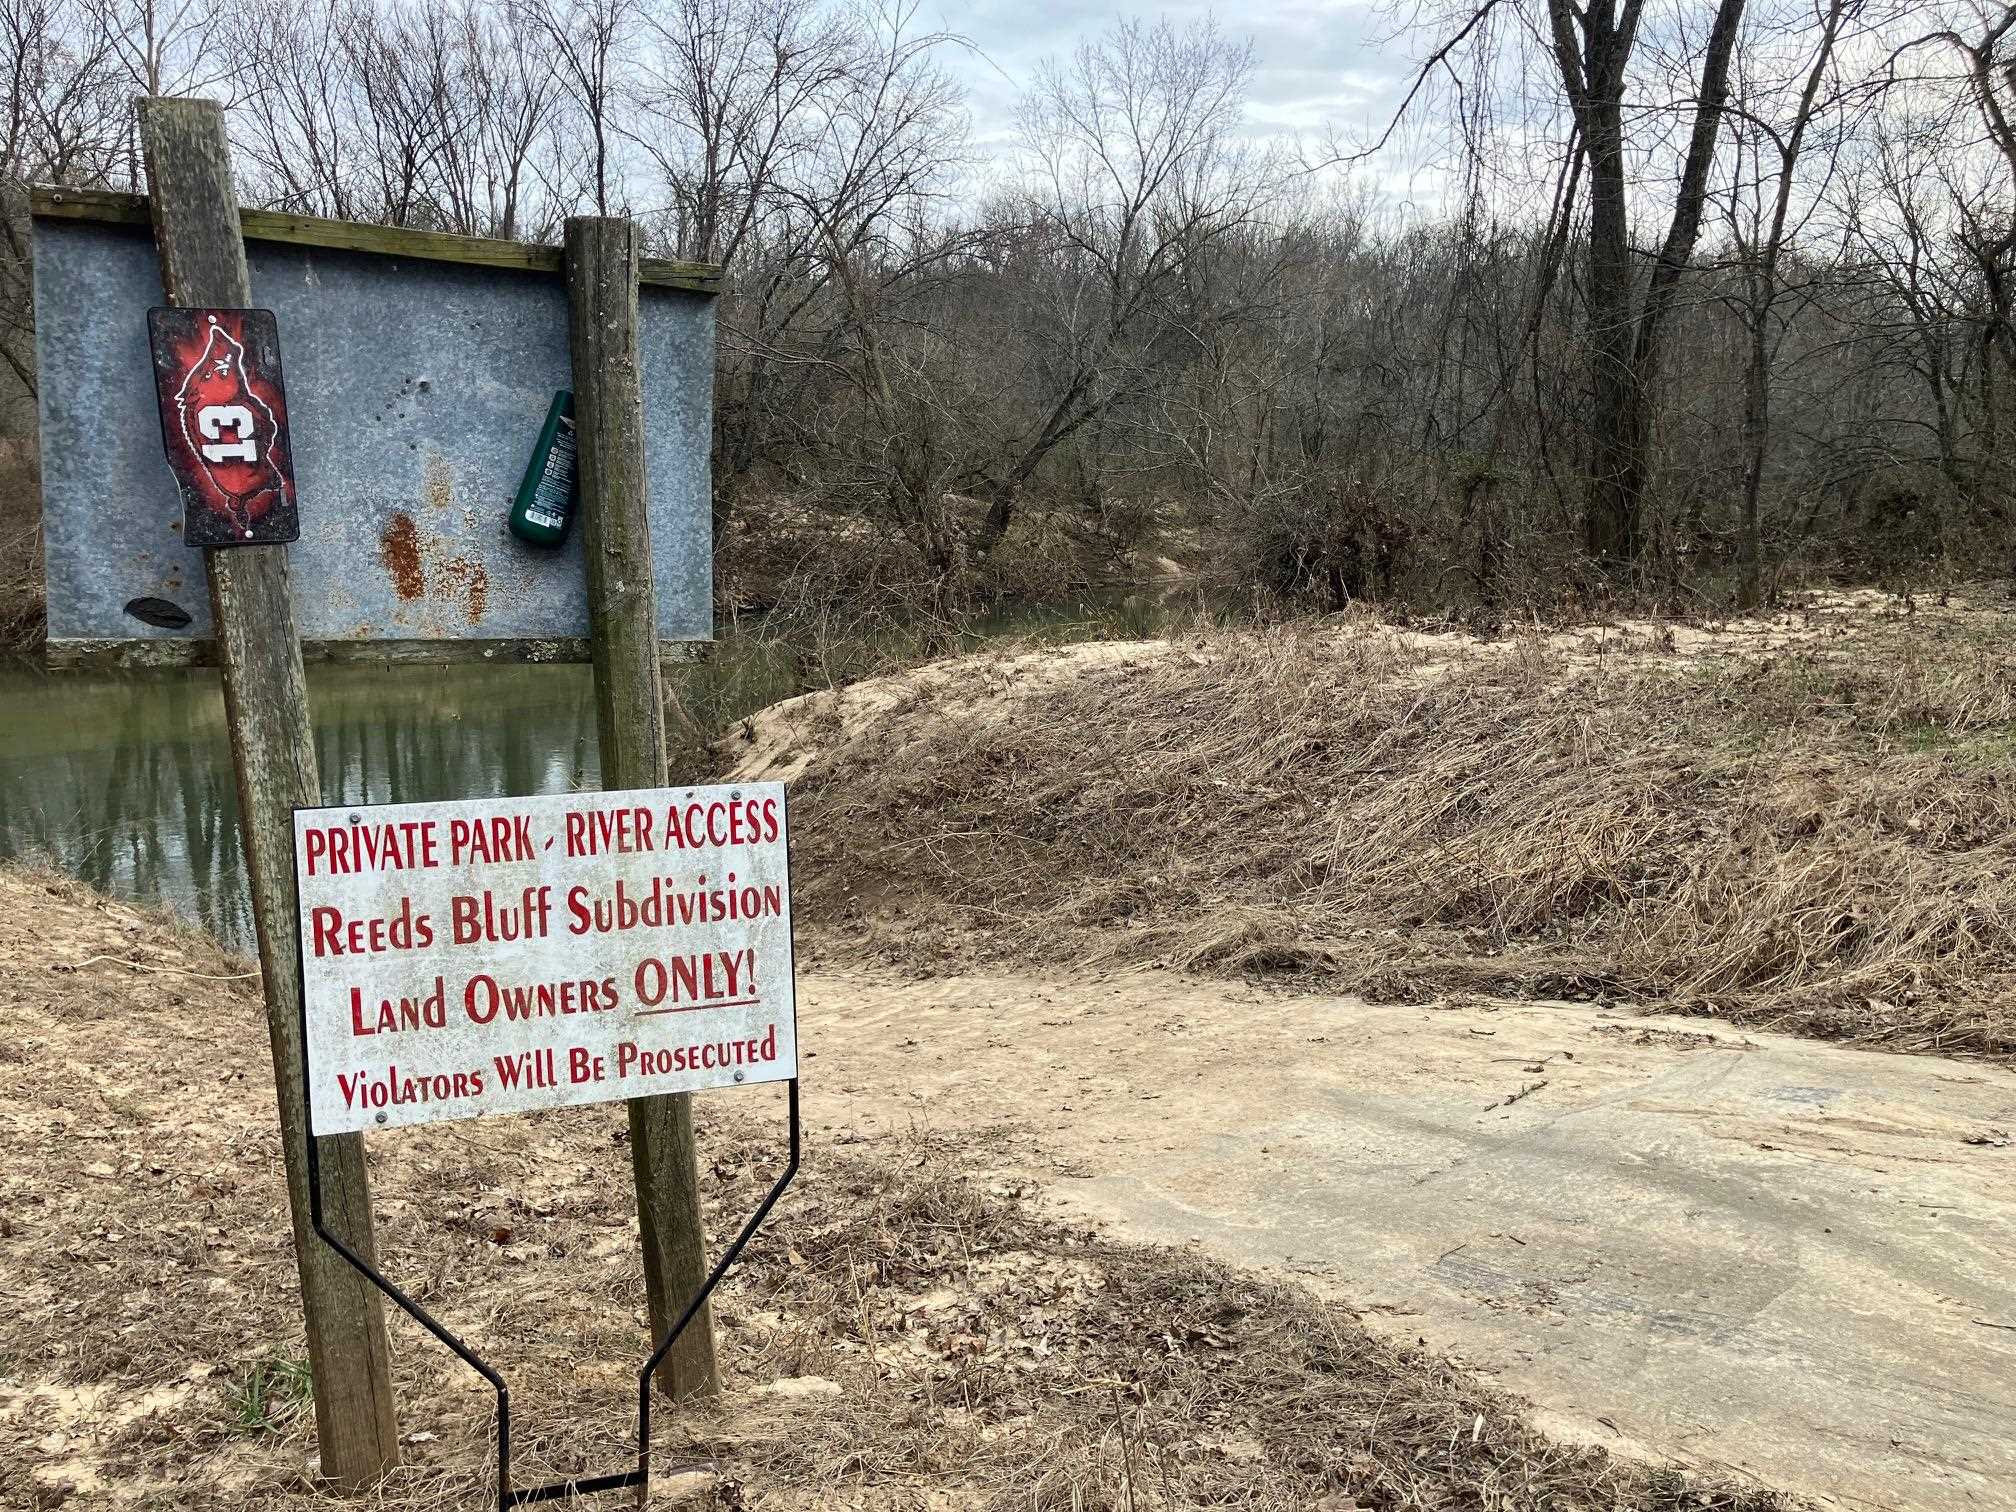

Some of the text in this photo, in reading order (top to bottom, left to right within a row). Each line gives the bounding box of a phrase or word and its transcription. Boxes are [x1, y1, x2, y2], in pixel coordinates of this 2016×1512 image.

[199, 405, 257, 462] 13
[305, 822, 438, 876] PRIVATE
[450, 816, 535, 866] PARK
[566, 807, 654, 857] RIVER
[665, 798, 780, 849] ACCESS
[451, 886, 551, 945] Bluff
[567, 873, 781, 935] Subdivision
[635, 948, 756, 1005] ONLY!
[494, 1047, 557, 1090] Will
